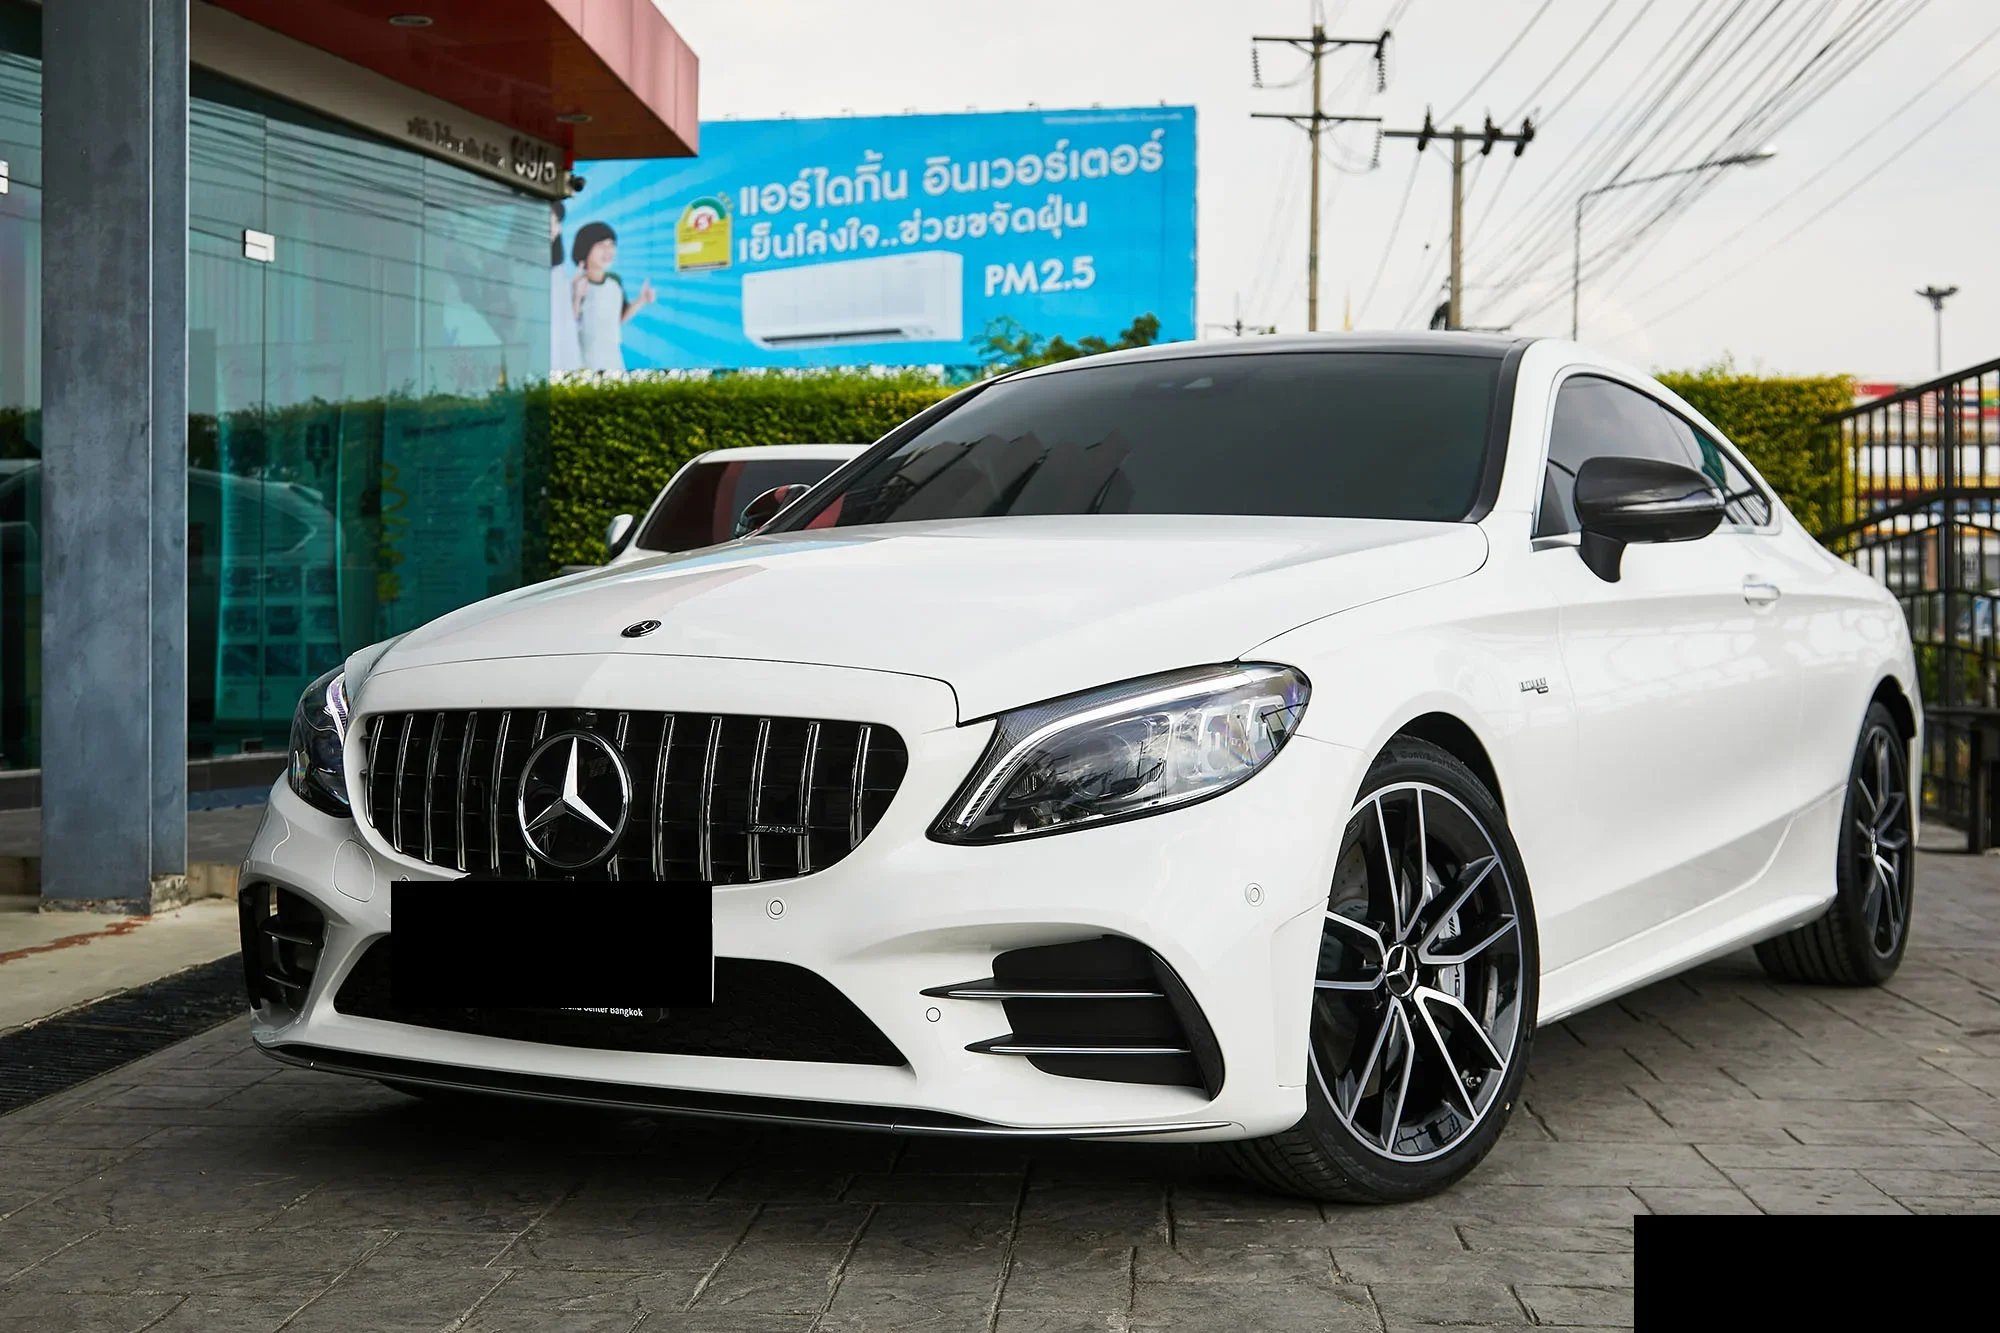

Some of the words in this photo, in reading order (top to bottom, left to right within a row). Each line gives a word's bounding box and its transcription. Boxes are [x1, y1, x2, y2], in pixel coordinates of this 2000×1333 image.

[740, 149, 908, 216] แอร์ไดกิ้น
[922, 127, 1165, 197] อินเวอร์เตอร์
[984, 255, 1096, 297] PM2.5
[610, 1007, 644, 1018] Bangkok
